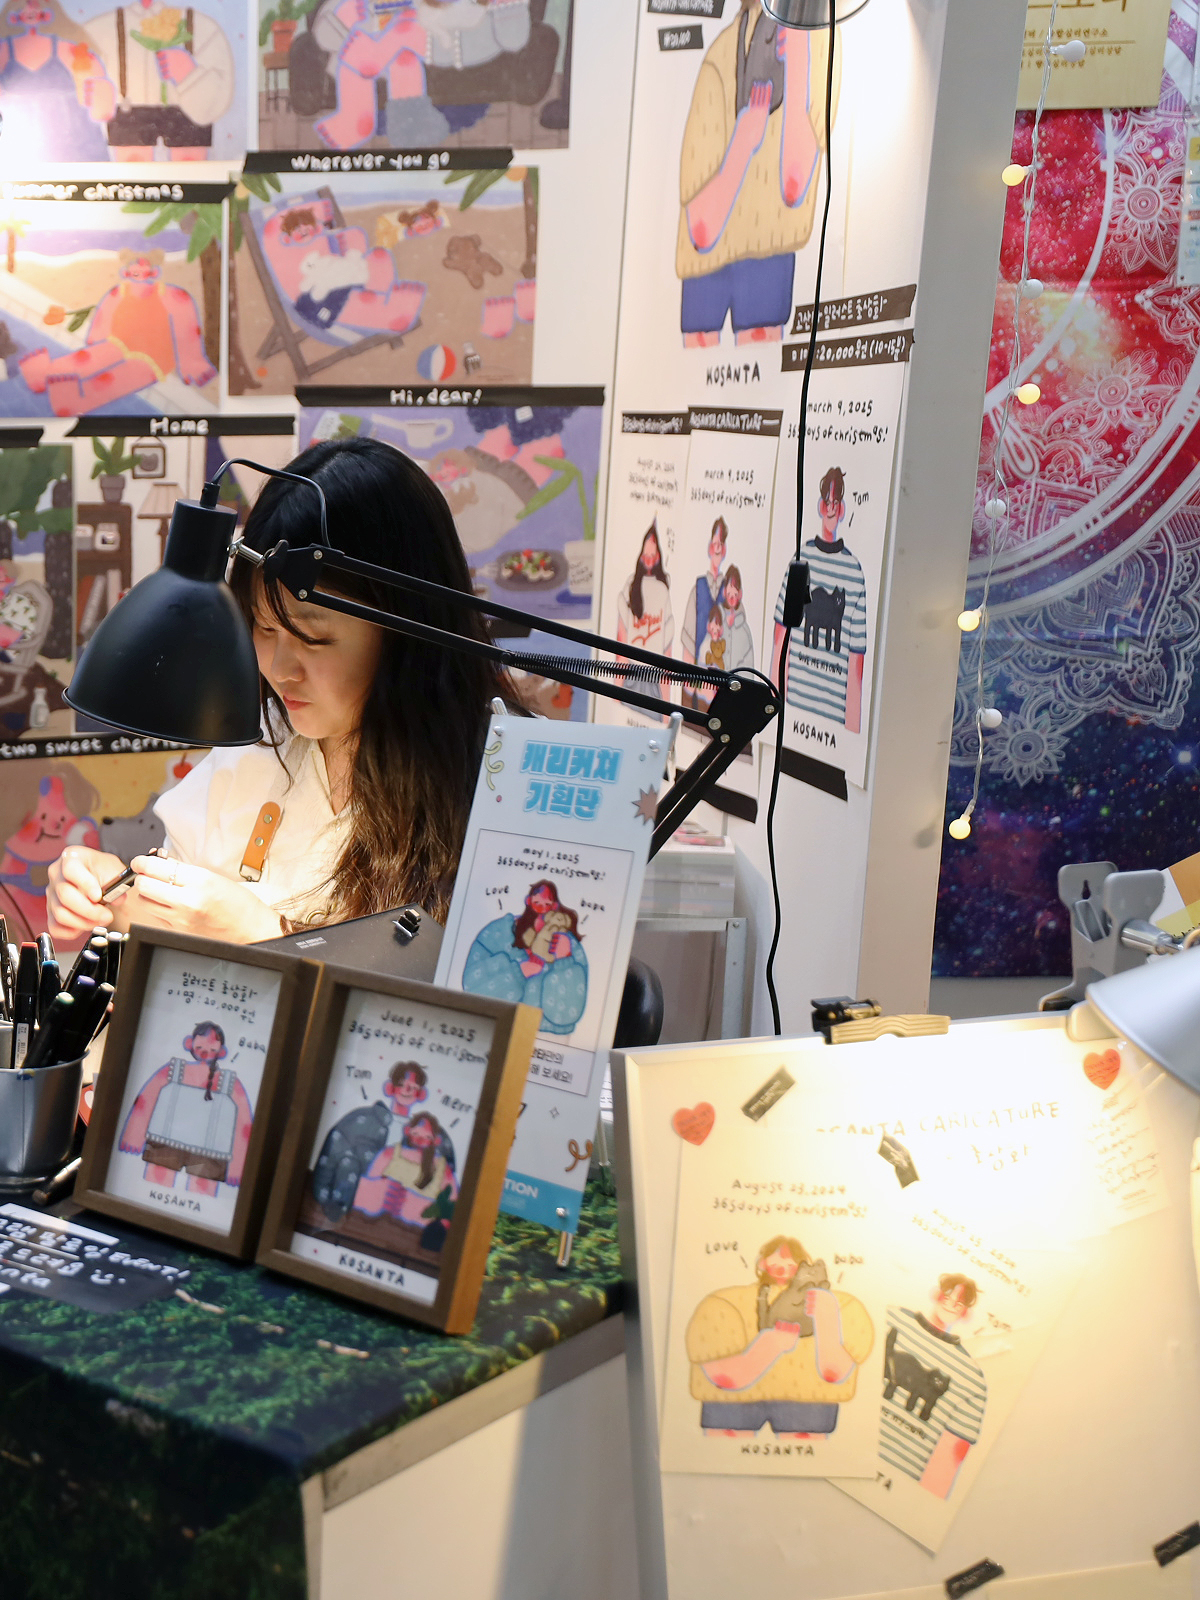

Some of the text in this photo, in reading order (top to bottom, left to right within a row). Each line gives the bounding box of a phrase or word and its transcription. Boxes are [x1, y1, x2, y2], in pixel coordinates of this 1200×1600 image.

[291, 151, 450, 171] Wherever you go
[83, 183, 185, 201] christmas
[824, 299, 854, 329] 일러스트
[855, 294, 888, 320] 초상화
[706, 361, 760, 387] KOSANTA
[806, 400, 832, 414] march
[848, 399, 873, 417] 2025
[150, 418, 209, 435] Home
[853, 491, 870, 506] Tom
[793, 720, 837, 749] KOSANTA
[45, 738, 103, 756] sweet
[524, 779, 601, 820] 기획관
[537, 863, 549, 871] of
[556, 852, 580, 864] 2025
[182, 971, 258, 1003] 일러스트 초상화
[381, 1010, 413, 1027] June
[440, 1023, 476, 1042] 2025
[408, 1037, 425, 1049] of
[346, 1065, 372, 1080] Tom
[920, 1101, 1060, 1133] CARICATURE
[150, 1190, 202, 1212] KOSANTA
[12, 1248, 85, 1278] 드려요
[39, 1230, 110, 1260] 팔로잉
[108, 1251, 192, 1283] EVENT!
[339, 1253, 405, 1287] KOSANTA
[740, 1444, 815, 1457] KOSANTA
